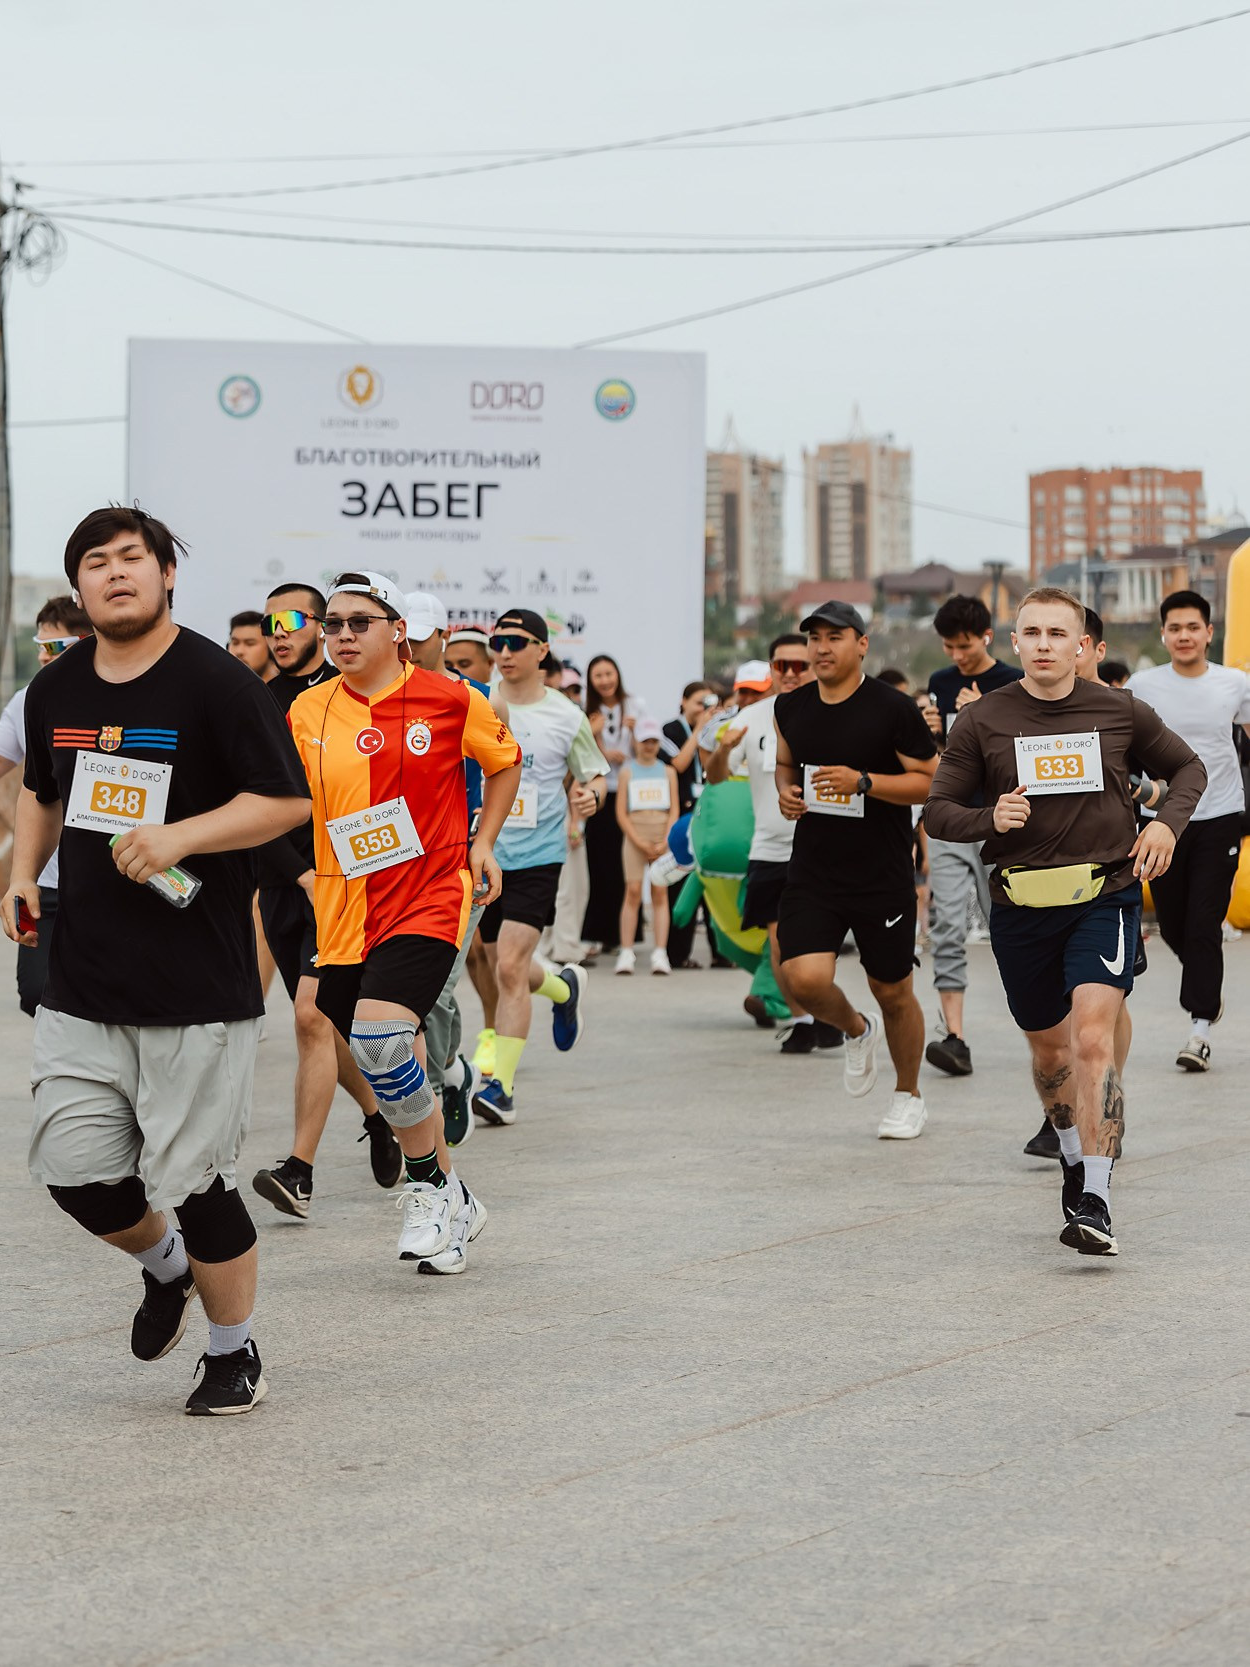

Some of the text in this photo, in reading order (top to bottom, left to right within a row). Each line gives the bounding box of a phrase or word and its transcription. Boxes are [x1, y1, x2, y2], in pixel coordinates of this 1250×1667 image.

[294, 446, 541, 469] БЛАГОТВОРИТЕЛЬНЫЙ
[341, 481, 500, 519] ЗАБЕГ
[359, 529, 481, 544] наши спонсоры
[1022, 740, 1093, 752] LEONE D'ORO
[84, 762, 161, 783] LEONE D'ORO
[1040, 757, 1079, 777] 333
[1027, 780, 1080, 789] БЛАГОТВОРИТЕЛЬНЫЙ
[96, 785, 141, 815] 348
[76, 813, 137, 828] БЛАГОТВОРИТЕЛЬНЫЙ
[335, 806, 401, 835] LEONE D'ORO
[354, 828, 395, 856] 358
[349, 846, 414, 872] БЛАГОТВОРИТЕЛЬНЫЙ ЗАБЕГ
